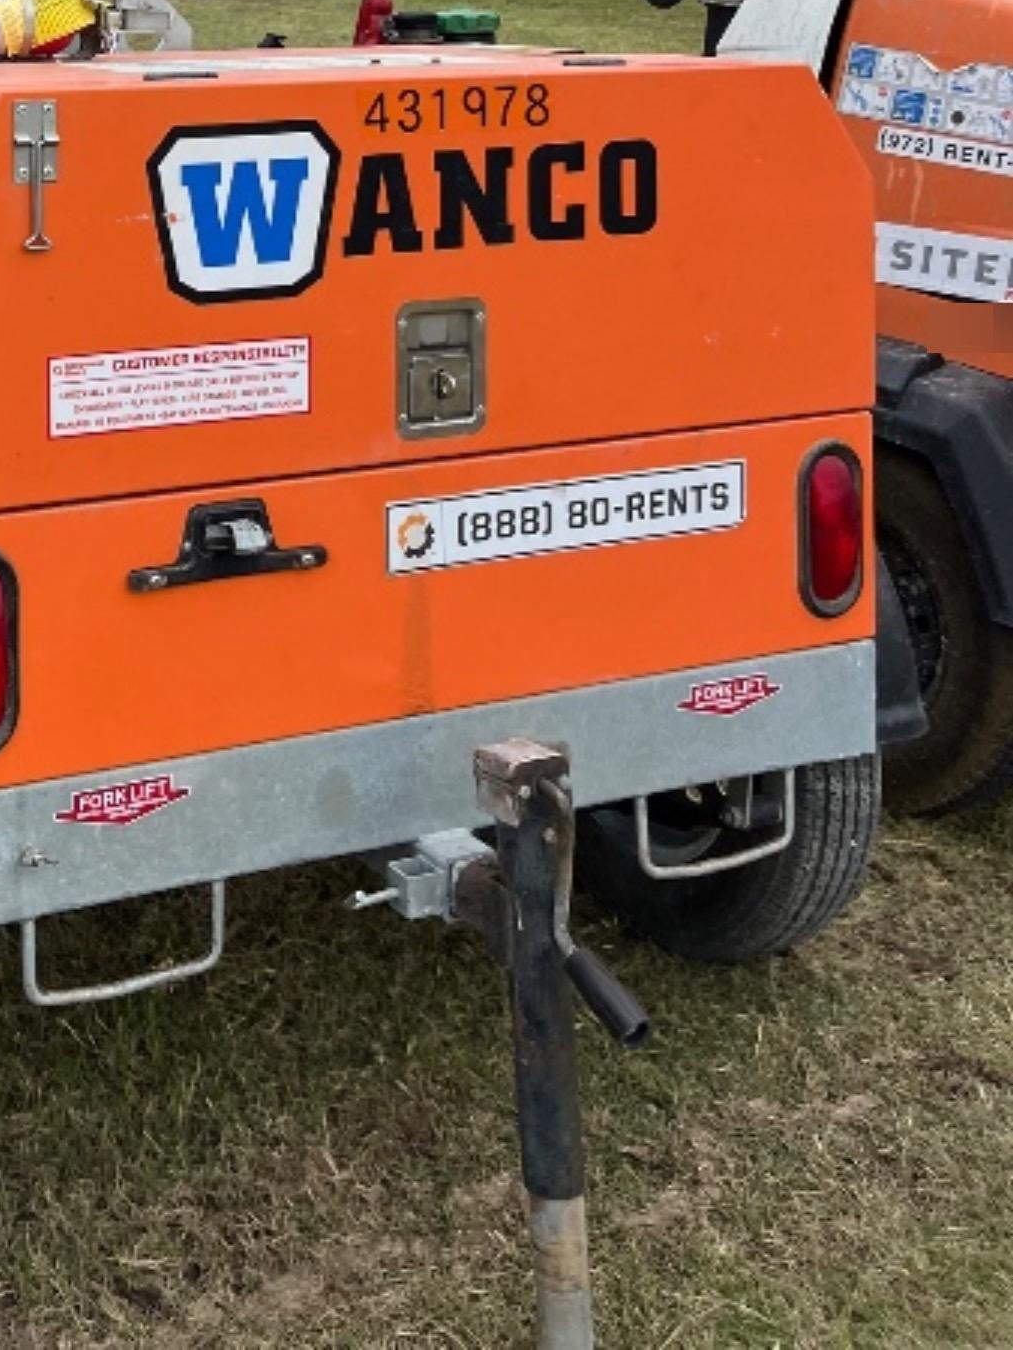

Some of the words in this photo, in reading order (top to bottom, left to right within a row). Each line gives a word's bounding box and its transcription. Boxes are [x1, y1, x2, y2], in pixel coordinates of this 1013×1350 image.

[364, 83, 550, 134] 431978
[880, 129, 934, 157] (972)
[890, 240, 1013, 288] SITE
[112, 352, 190, 373] CUSTOMER
[194, 344, 307, 364] RESPONSIBILITY
[457, 501, 552, 547] (888)
[567, 482, 730, 529] 80-RENTS
